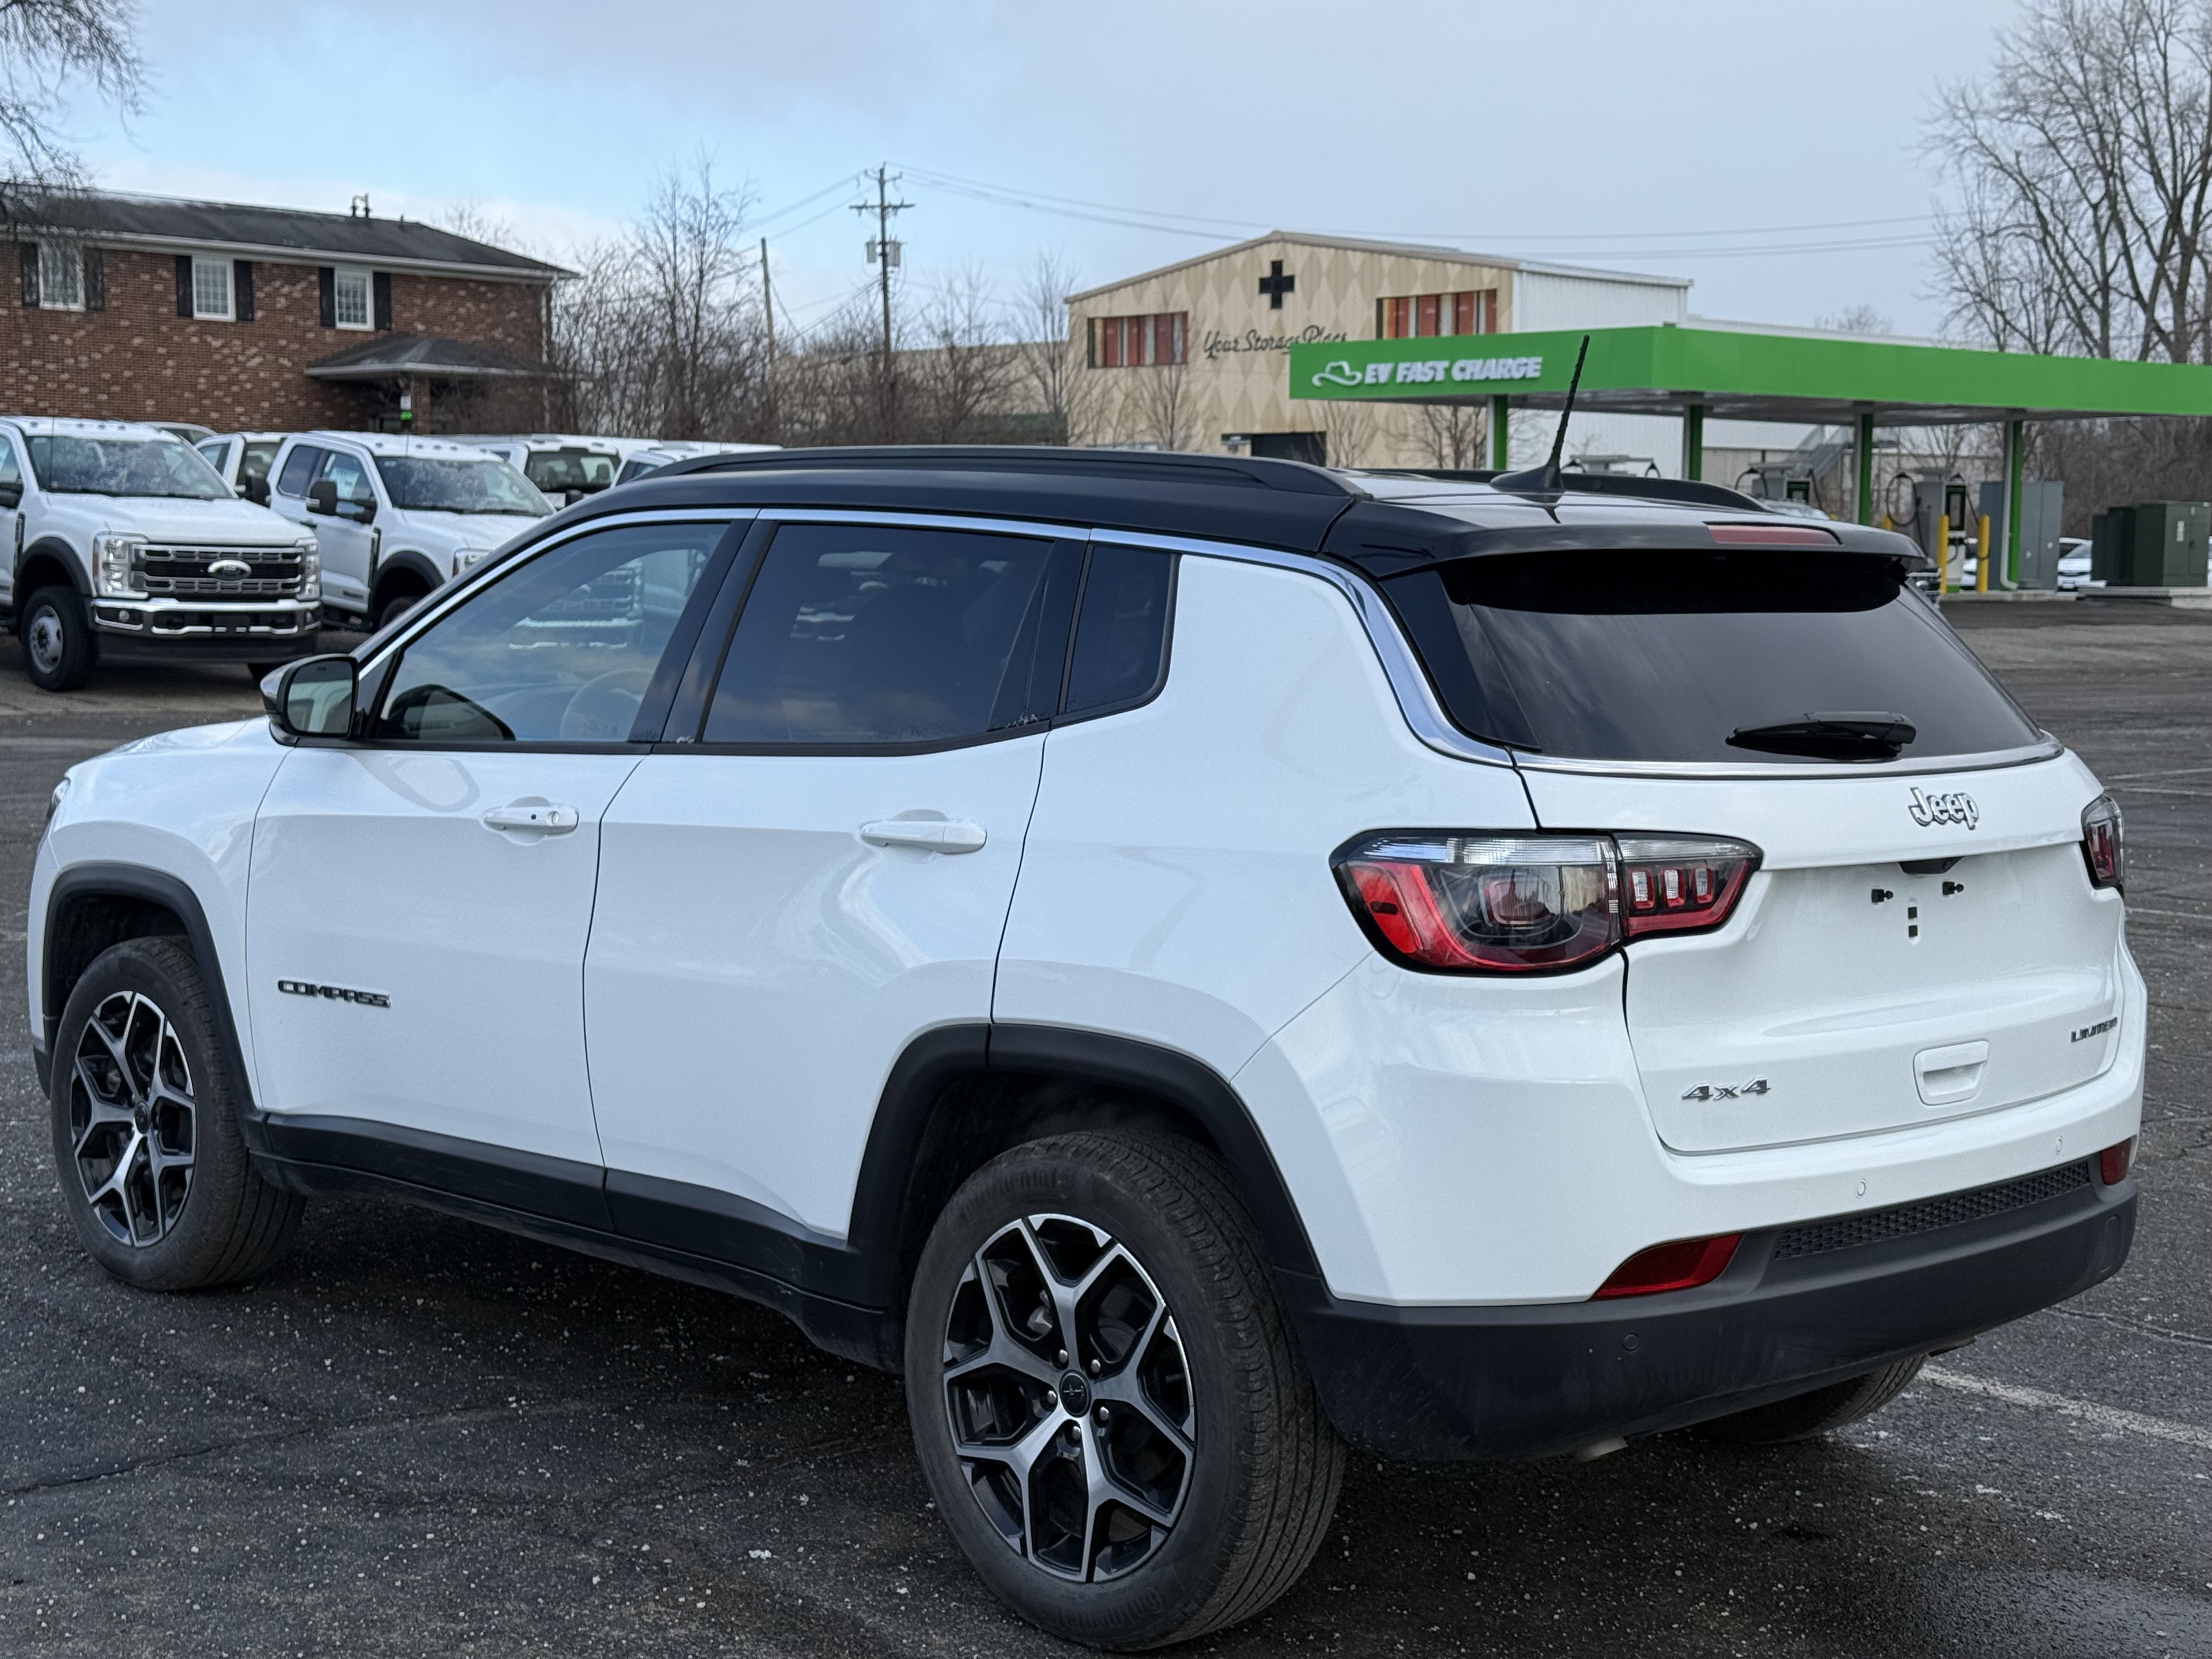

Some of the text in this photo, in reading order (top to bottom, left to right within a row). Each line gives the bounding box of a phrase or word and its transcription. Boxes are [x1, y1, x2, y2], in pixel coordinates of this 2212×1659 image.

[1203, 329, 1240, 360] Your
[1364, 356, 1543, 385] EV FAST CHARGE
[1908, 786, 1980, 831] Jeep
[278, 979, 391, 1009] COMPASS
[2070, 1016, 2118, 1043] LIMITED
[1681, 1076, 1771, 1102] 4x4
